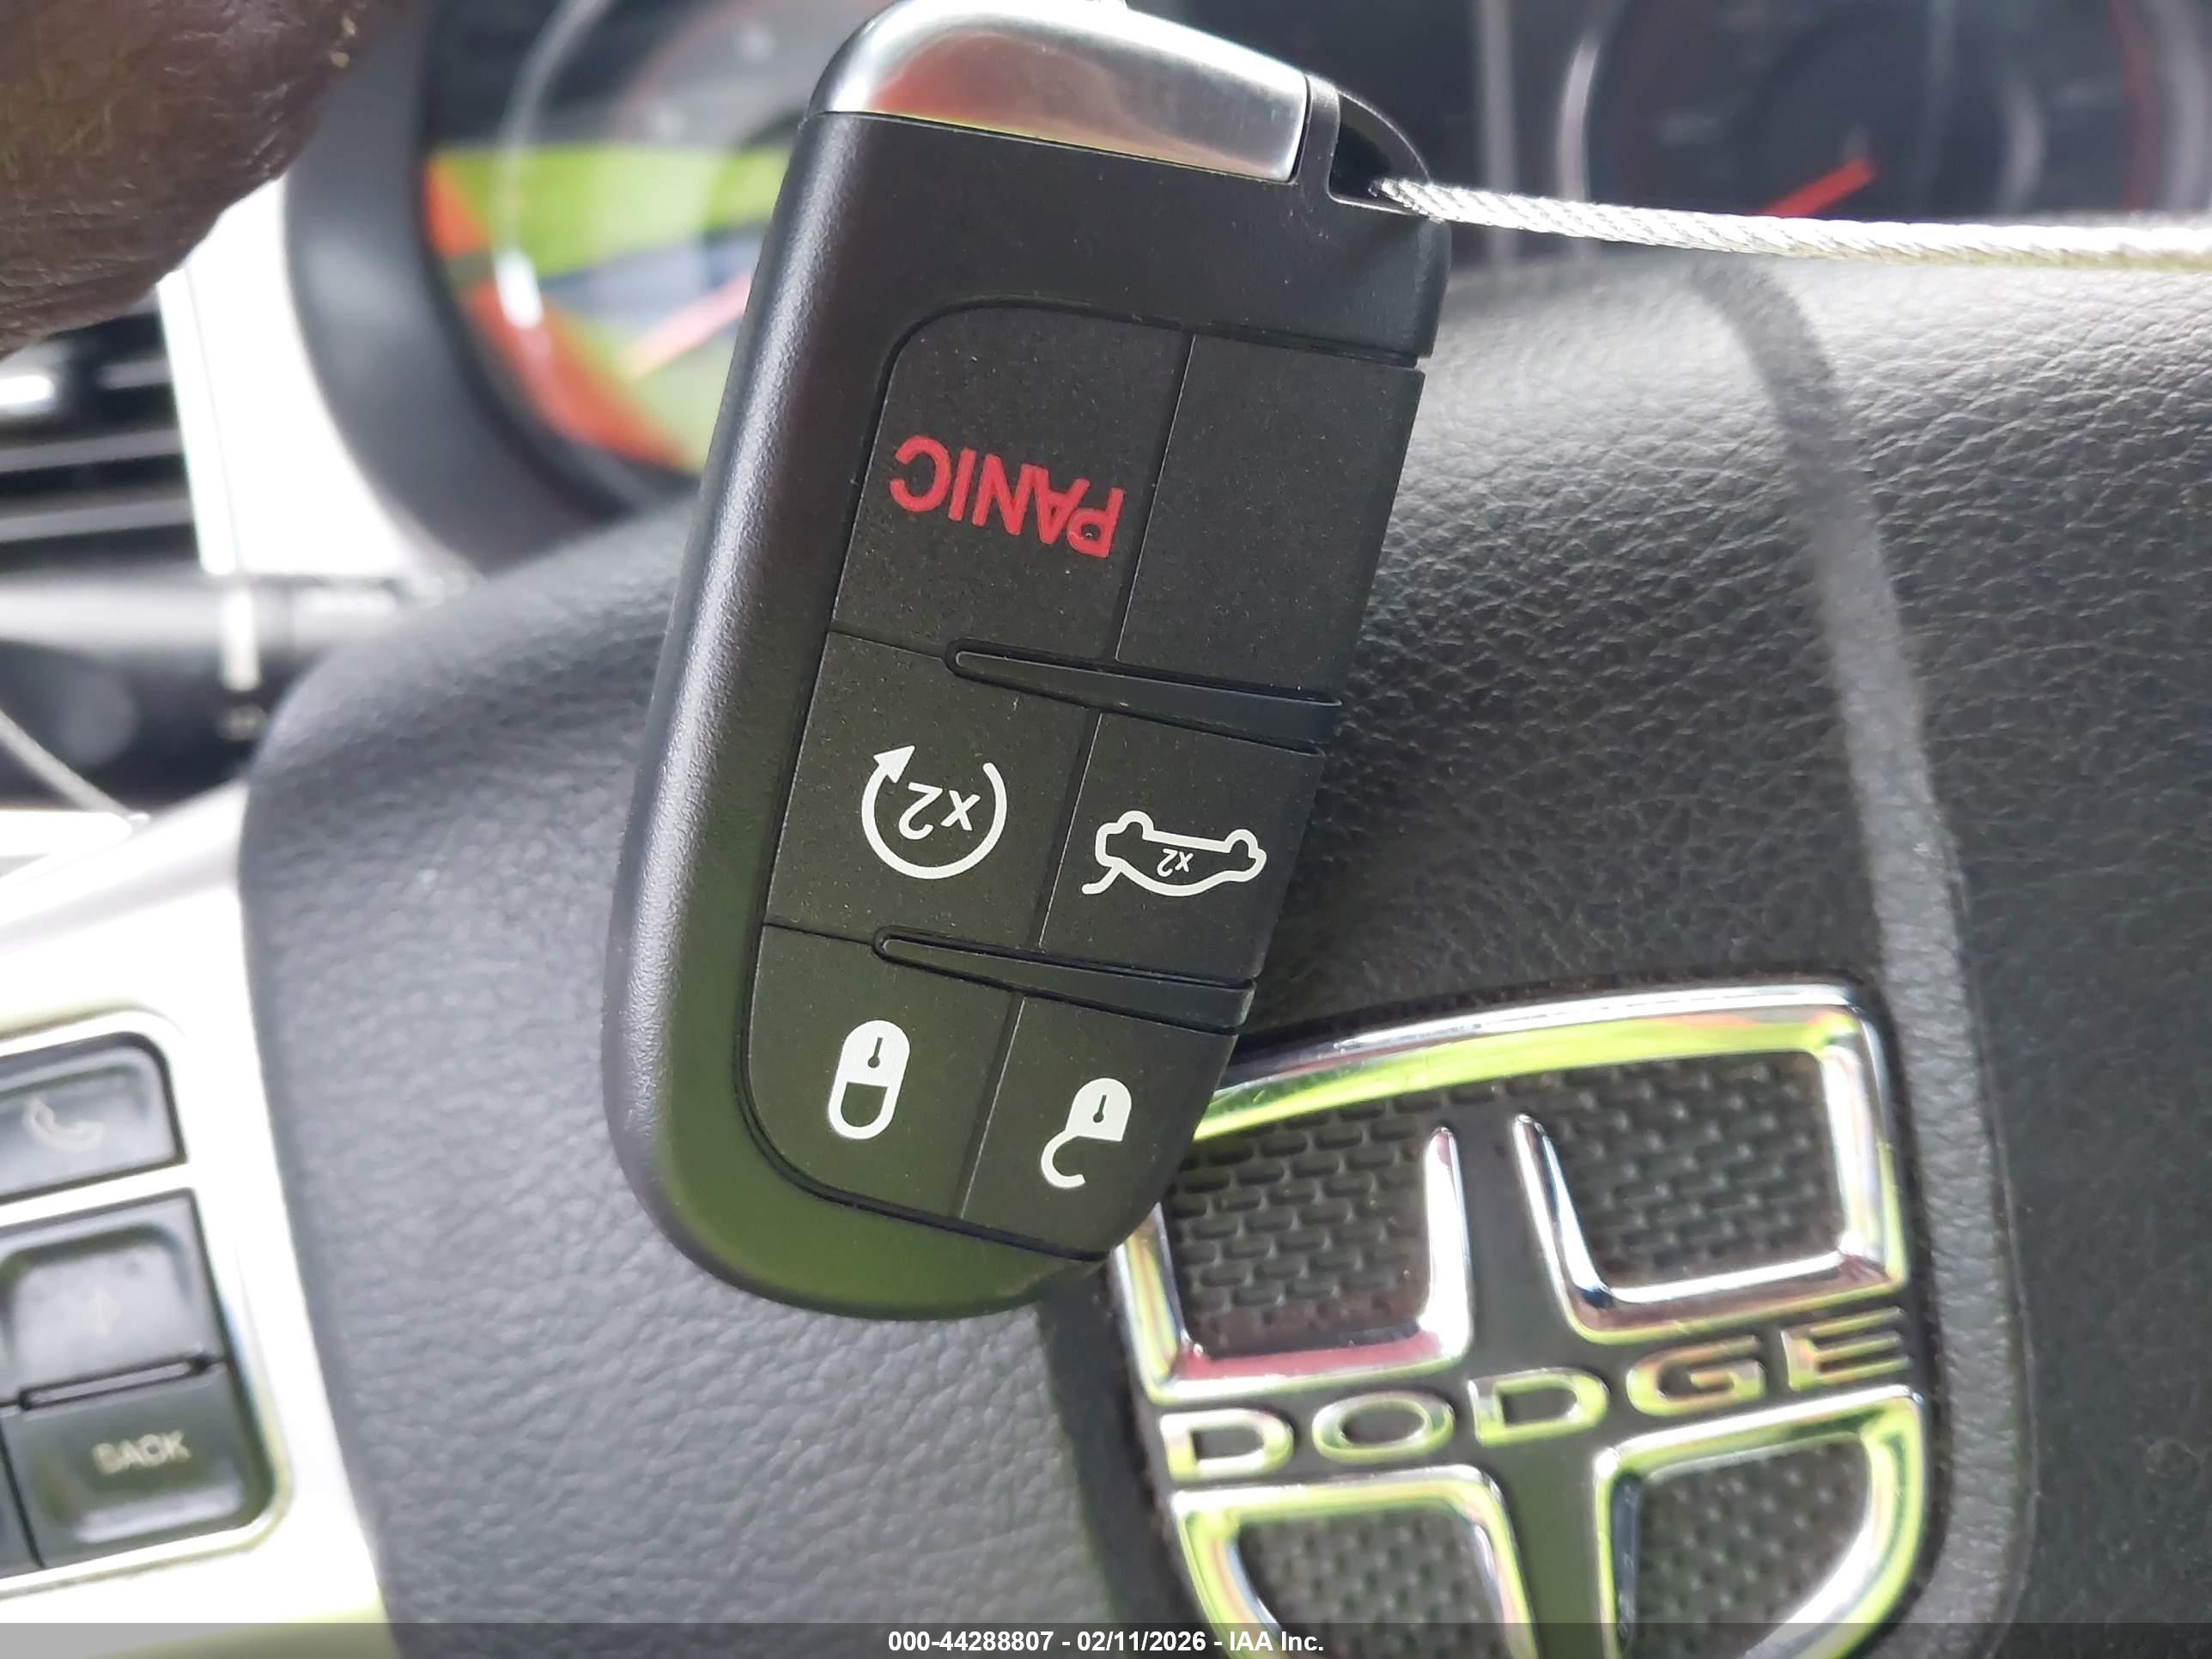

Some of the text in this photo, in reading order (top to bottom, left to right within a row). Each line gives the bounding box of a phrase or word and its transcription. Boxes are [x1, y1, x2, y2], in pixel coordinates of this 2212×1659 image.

[890, 435, 1126, 558] PANIC
[898, 781, 981, 840] x2
[1156, 848, 1194, 878] x2
[1159, 1307, 1913, 1480] DODGE
[93, 1430, 190, 1474] BACK
